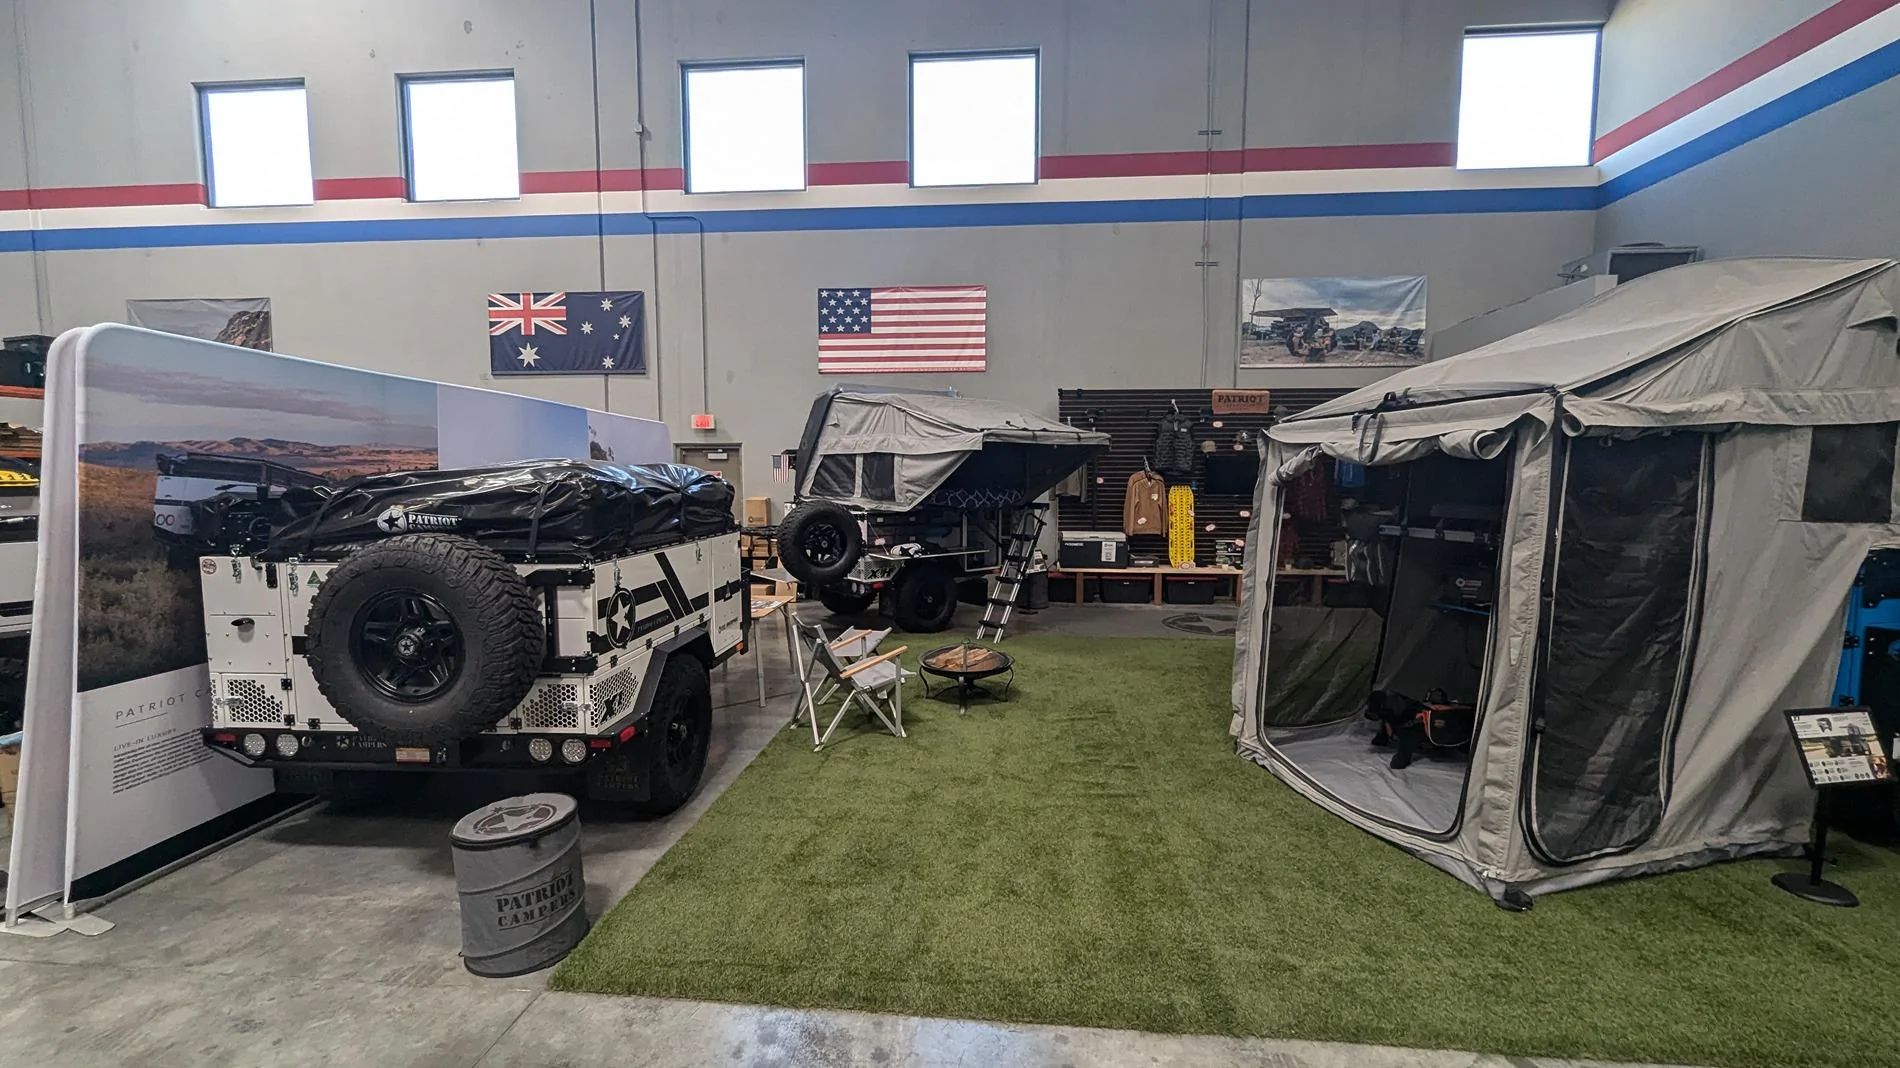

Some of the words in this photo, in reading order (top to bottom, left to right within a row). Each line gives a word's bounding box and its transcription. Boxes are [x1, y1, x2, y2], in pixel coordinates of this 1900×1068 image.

[1218, 395, 1264, 403] PATRIOT
[409, 514, 458, 526] PATRIOT
[115, 693, 185, 720] PATRIOT
[496, 873, 574, 913] PATRIOT
[497, 890, 577, 928] CAMPERS
